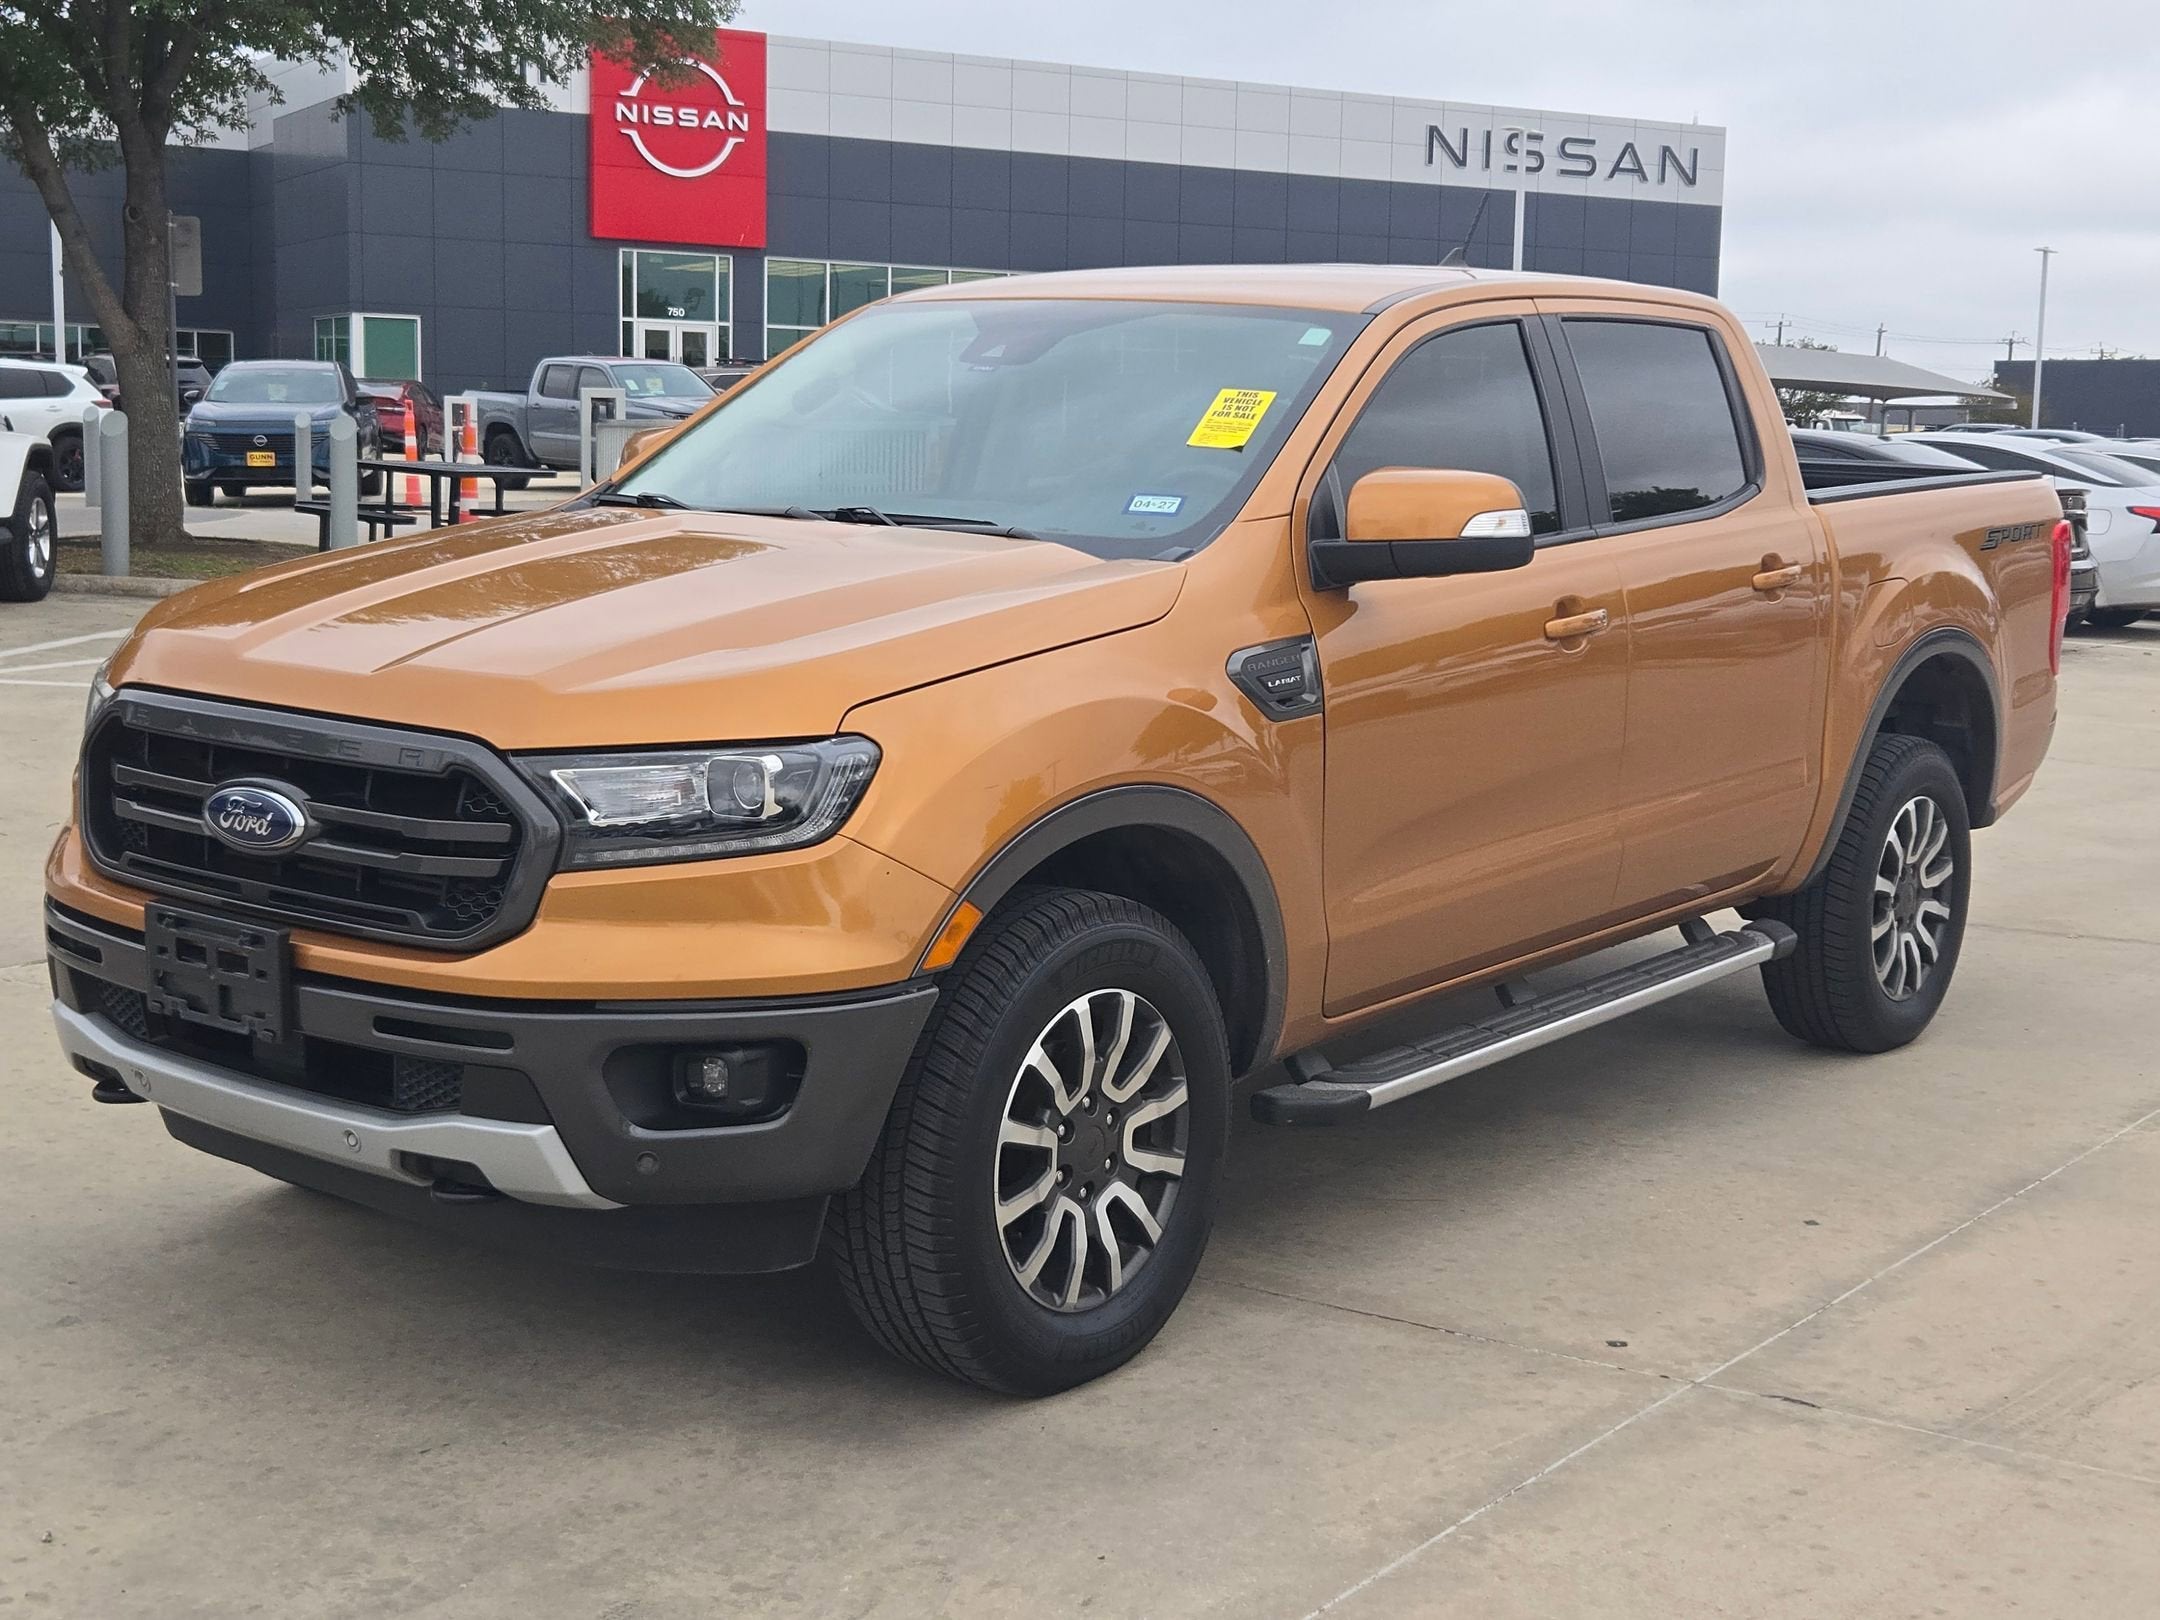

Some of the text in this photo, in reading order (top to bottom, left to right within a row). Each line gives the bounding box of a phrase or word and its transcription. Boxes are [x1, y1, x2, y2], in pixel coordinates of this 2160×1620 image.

[615, 102, 749, 132] NISSAN
[1425, 124, 1699, 187] NISSAN
[667, 306, 685, 317] 750
[1223, 397, 1264, 406] VEHICLE
[1236, 391, 1259, 399] THIS
[1232, 412, 1257, 420] SALE
[1979, 522, 2046, 551] SPORT
[220, 795, 274, 836] Ford
